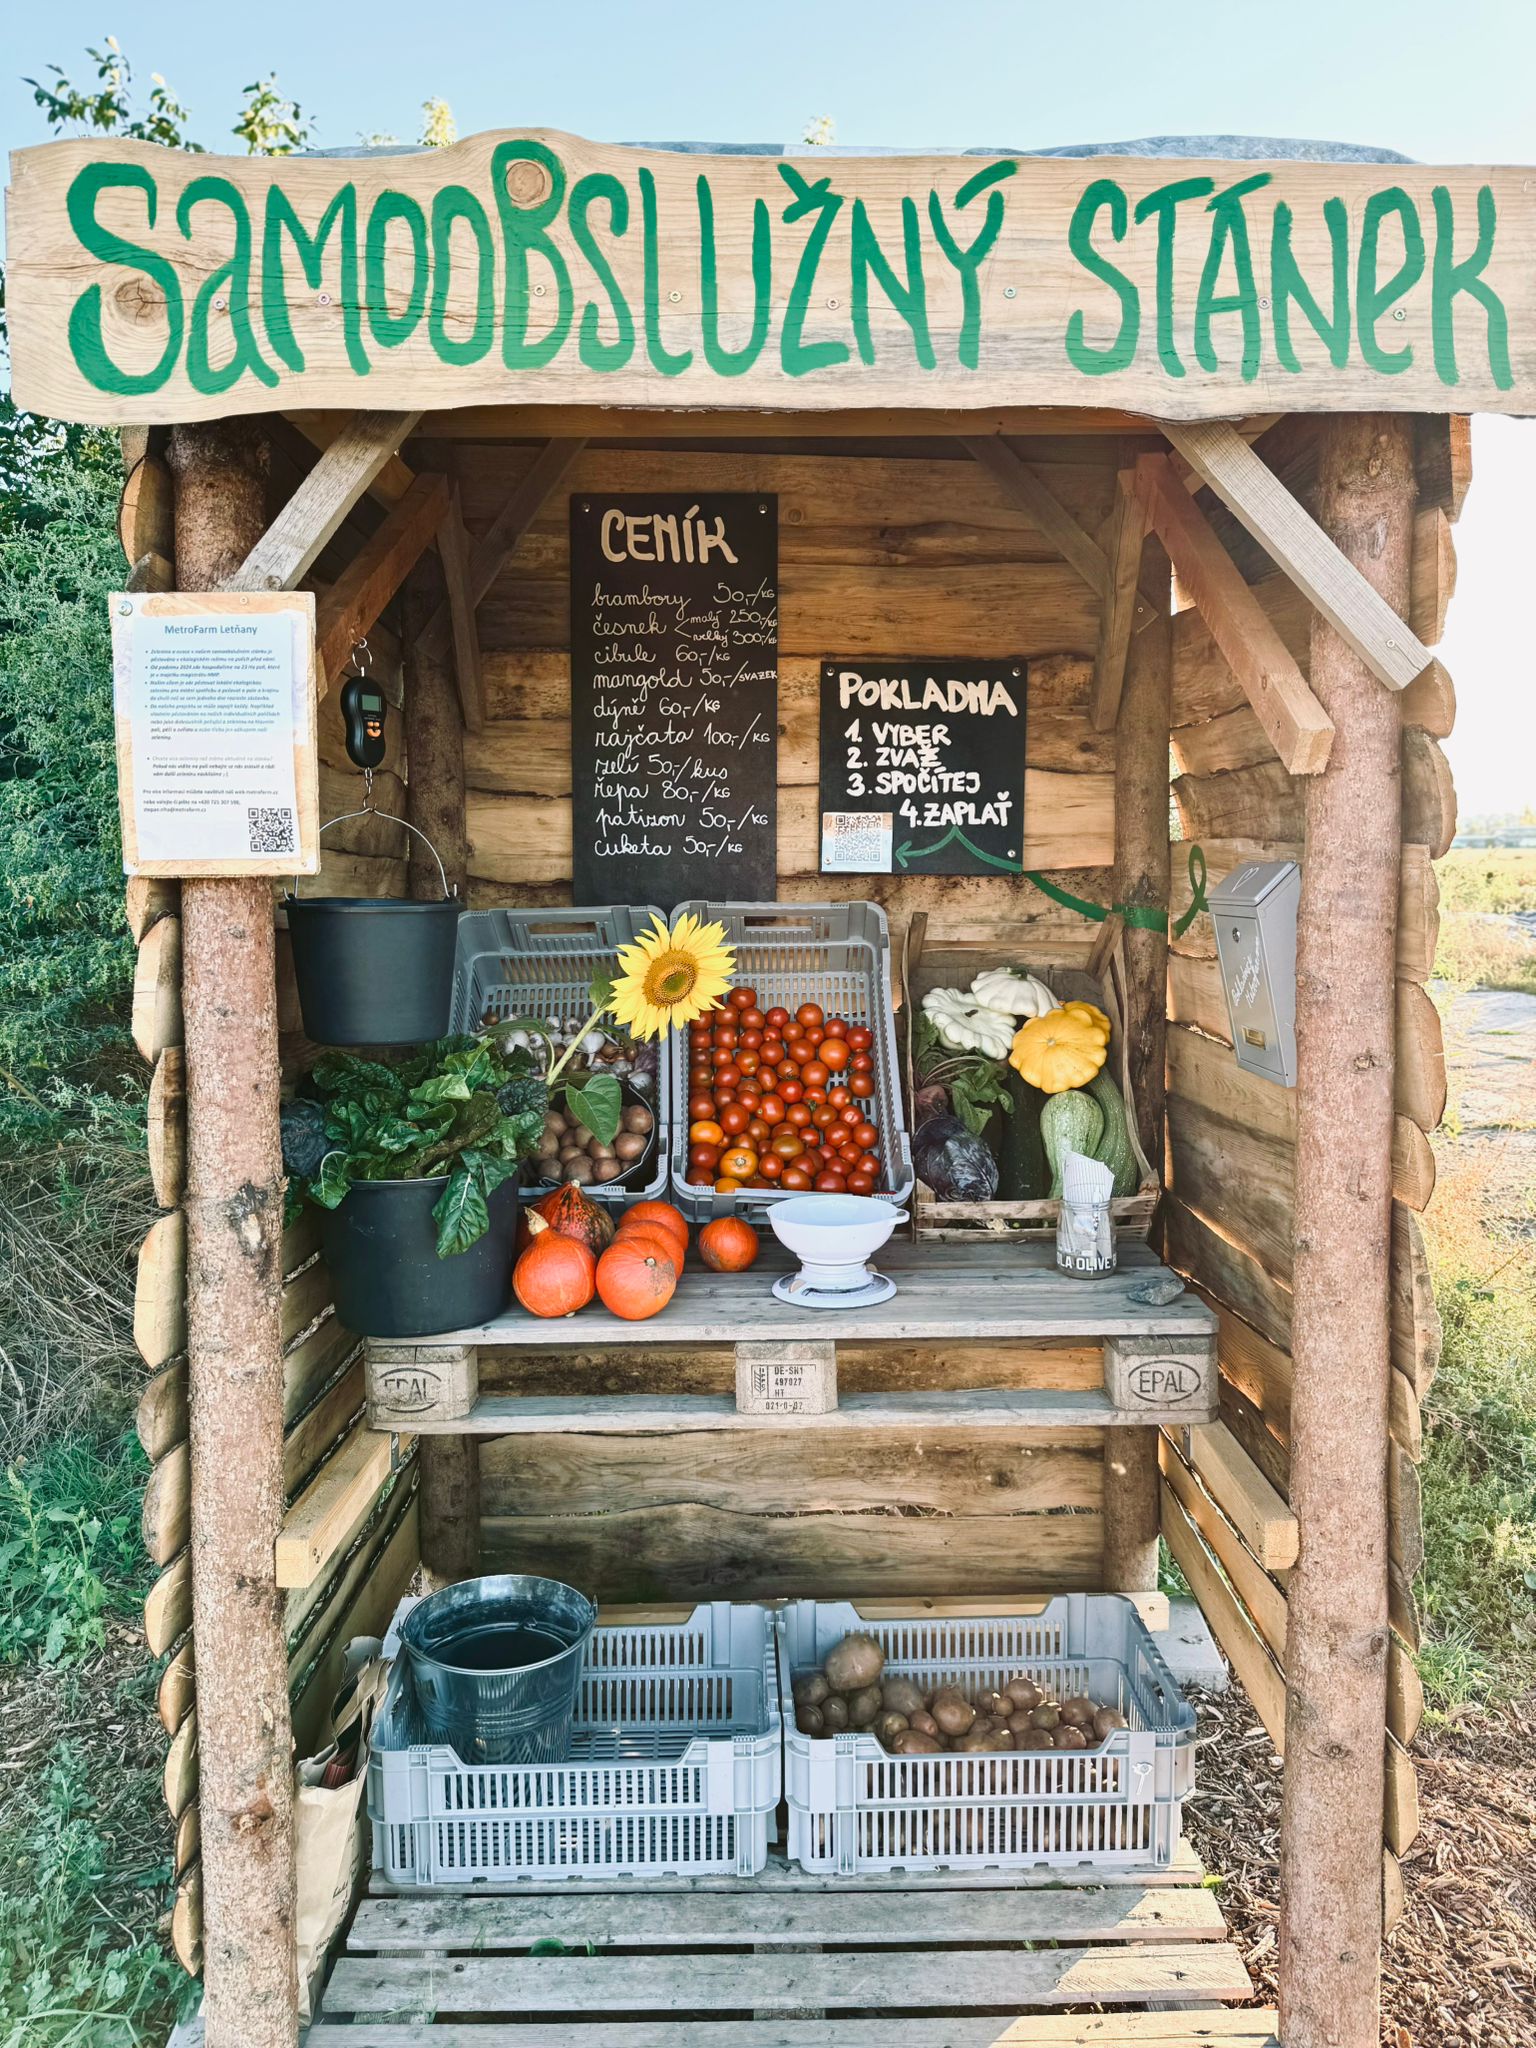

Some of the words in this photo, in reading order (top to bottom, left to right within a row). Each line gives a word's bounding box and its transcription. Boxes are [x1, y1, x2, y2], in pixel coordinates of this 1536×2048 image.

[601, 504, 738, 563] CENÍK
[592, 582, 691, 620] brambory
[164, 624, 218, 635] MetroFarm
[220, 624, 258, 636] Letňany
[593, 611, 667, 635] česnek
[690, 610, 722, 629] malý
[594, 643, 656, 664] cibule
[593, 667, 692, 702] mangold
[839, 672, 1018, 717] POKLADNA
[593, 696, 645, 729] dýně
[595, 719, 694, 758] rajčata
[844, 718, 863, 743] 1.
[872, 722, 952, 746] VYBER
[595, 752, 639, 775] zelí
[846, 747, 868, 769] 2.
[875, 743, 942, 768] ZVAŽ
[594, 776, 649, 813] řepa
[594, 834, 671, 856] cuketa
[1076, 1256, 1112, 1271] OLIVE
[1139, 1370, 1188, 1393] EPAL
